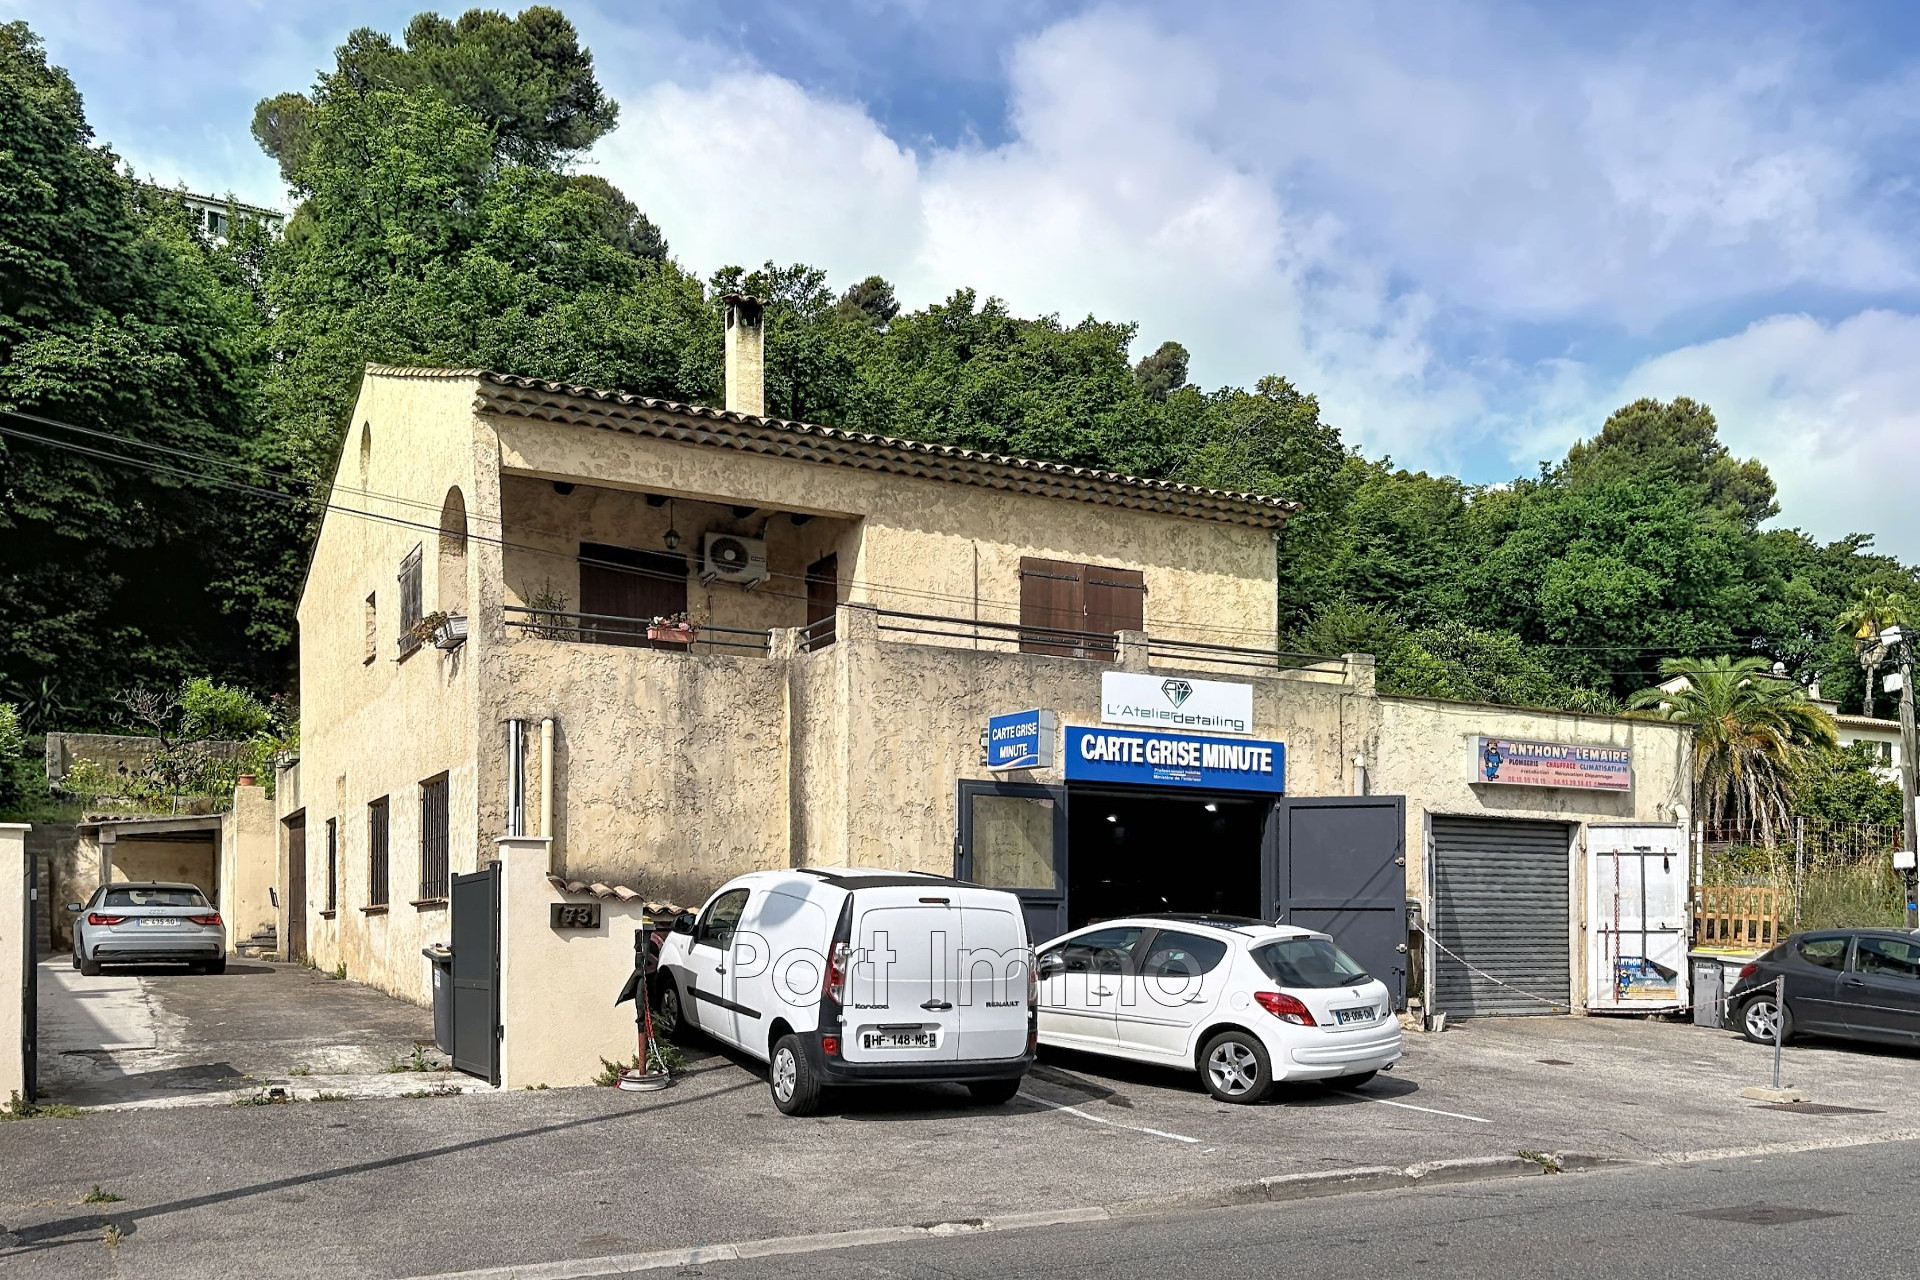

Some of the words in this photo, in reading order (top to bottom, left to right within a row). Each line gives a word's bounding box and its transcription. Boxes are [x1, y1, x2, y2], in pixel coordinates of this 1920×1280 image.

[992, 726, 1015, 741] CARTE
[1015, 722, 1037, 738] GRISE
[1000, 743, 1028, 759] MINUTE
[1080, 734, 1144, 763] CARTE
[1145, 739, 1200, 767] GRISE
[1202, 743, 1272, 772] MINUTE
[1508, 743, 1569, 759] ANTHONY
[1576, 747, 1629, 764] LEMAIRE
[1508, 759, 1538, 767] PLOMBERIE
[562, 906, 589, 923] 73
[872, 1034, 928, 1046] HF-148-MC
